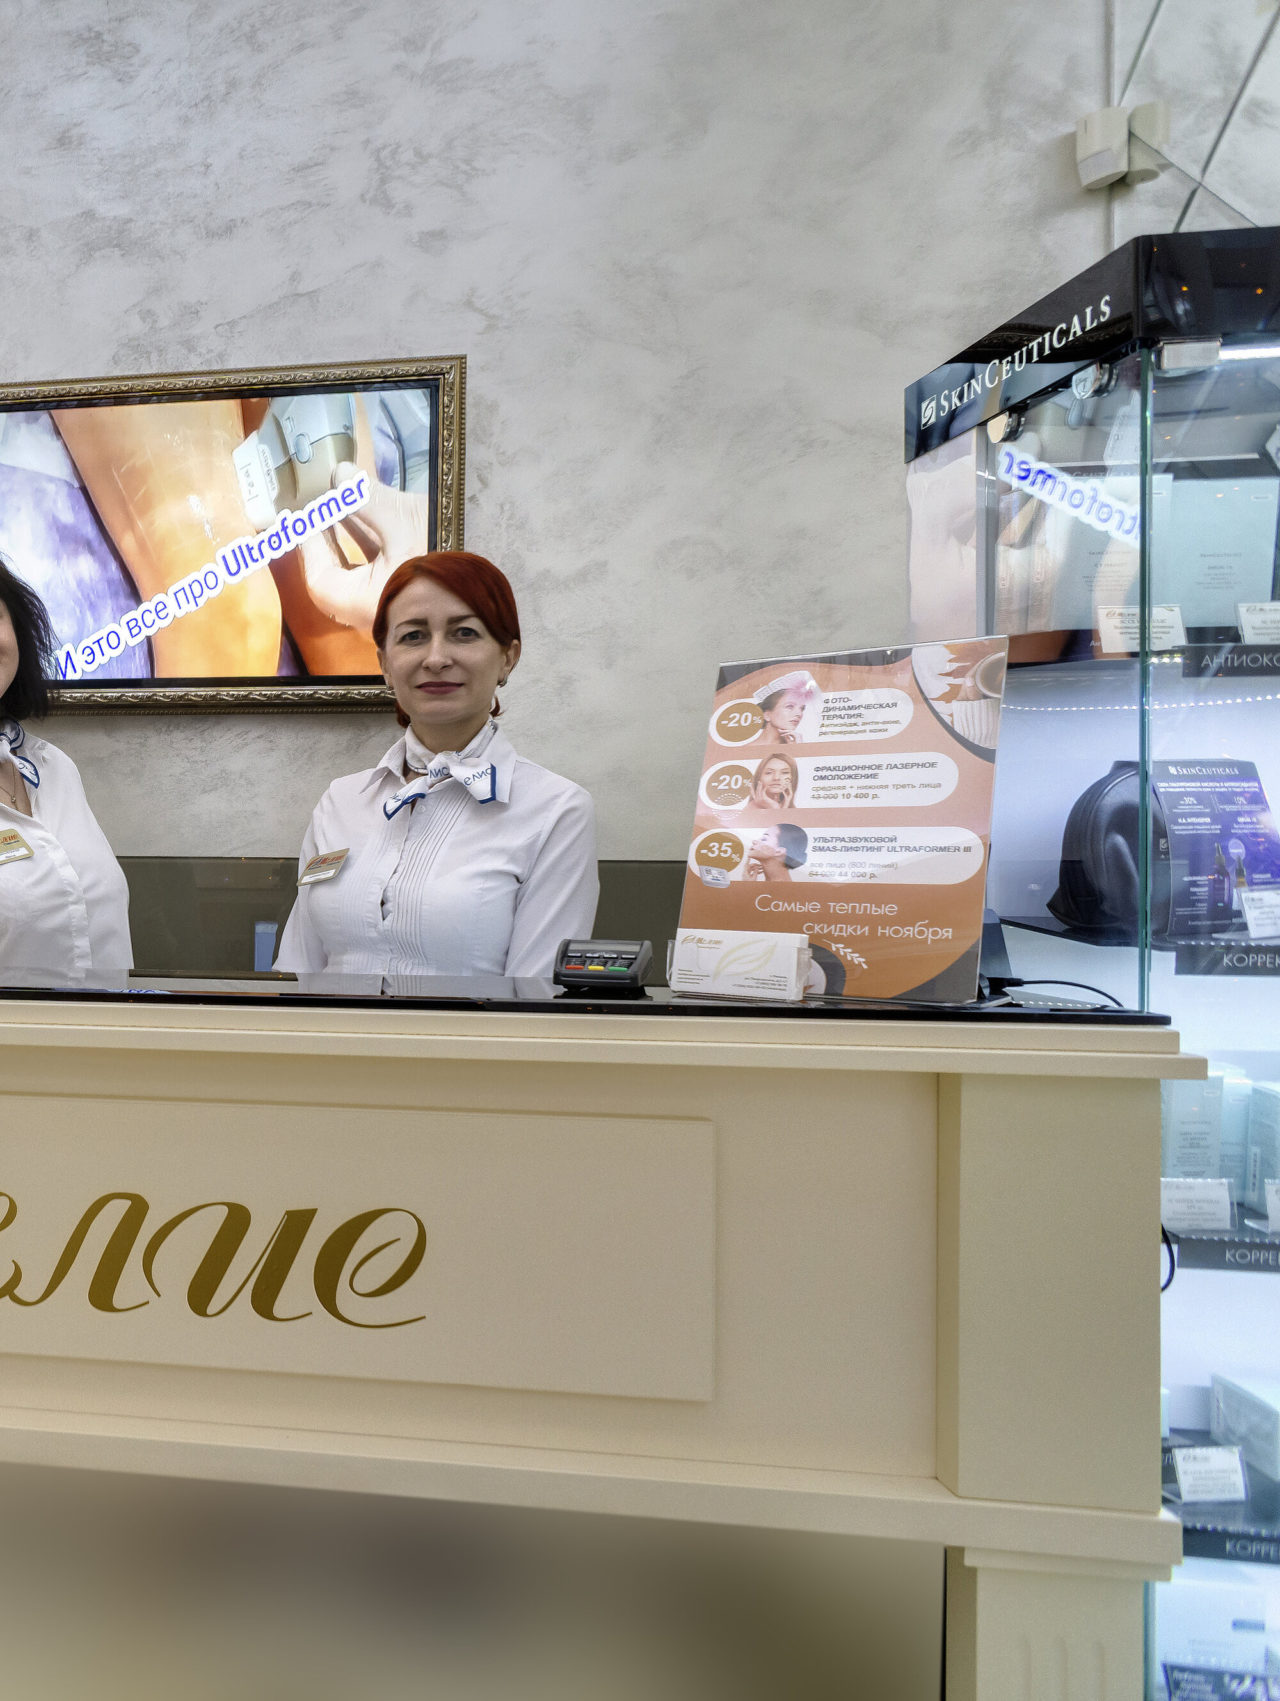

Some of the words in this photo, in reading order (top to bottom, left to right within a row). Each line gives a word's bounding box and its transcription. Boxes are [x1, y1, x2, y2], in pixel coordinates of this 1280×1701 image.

[55, 650, 77, 680] И
[81, 629, 122, 665] это
[125, 599, 169, 638] все
[173, 569, 219, 609] про
[221, 477, 369, 578] Ultraformer
[821, 702, 898, 714] ДИНАМИЧЕСКАЯ
[720, 712, 762, 728] -20%
[813, 763, 883, 773] ФРАКЦИОННОЕ
[885, 761, 938, 770] ЛАЗЕРНОЕ
[711, 774, 752, 790] -20%
[813, 773, 879, 782] ОМОЛОЖЕНИЕ
[812, 835, 898, 844] УЛЬТРАЗВУКОВОЙ
[700, 841, 741, 864] -35%
[811, 845, 885, 853] SMAS-ЛИФТИНГ
[886, 845, 961, 853] ULTRAFORMER
[754, 894, 821, 913] Самые
[827, 901, 899, 916] теплые
[802, 922, 870, 939] скидки
[877, 920, 953, 944] ноября
[1225, 1248, 1280, 1267] КОРРЕ
